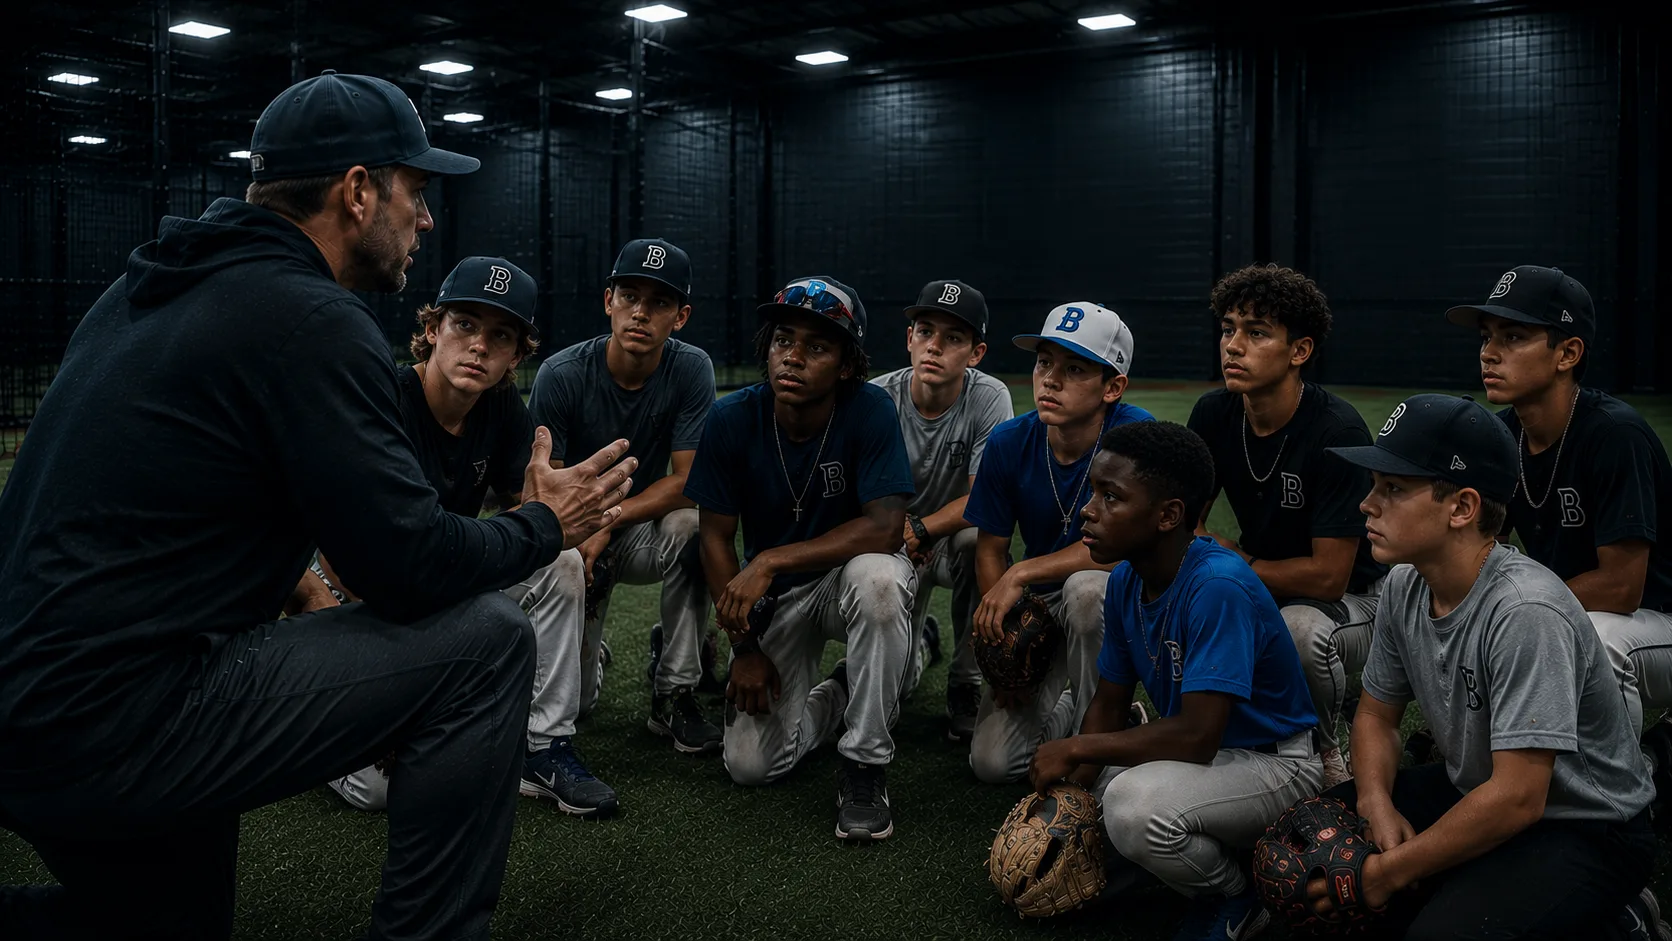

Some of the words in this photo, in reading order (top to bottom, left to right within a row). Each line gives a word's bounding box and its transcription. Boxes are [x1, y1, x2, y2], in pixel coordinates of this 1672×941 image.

[642, 245, 667, 269] B
[485, 266, 511, 294] B
[938, 283, 962, 306] B
[1489, 271, 1518, 299] B
[1056, 307, 1085, 331] B
[1378, 402, 1408, 436] B
[820, 460, 846, 498] B
[1280, 472, 1305, 509] B
[1557, 487, 1586, 528] B
[1459, 666, 1484, 711] B
